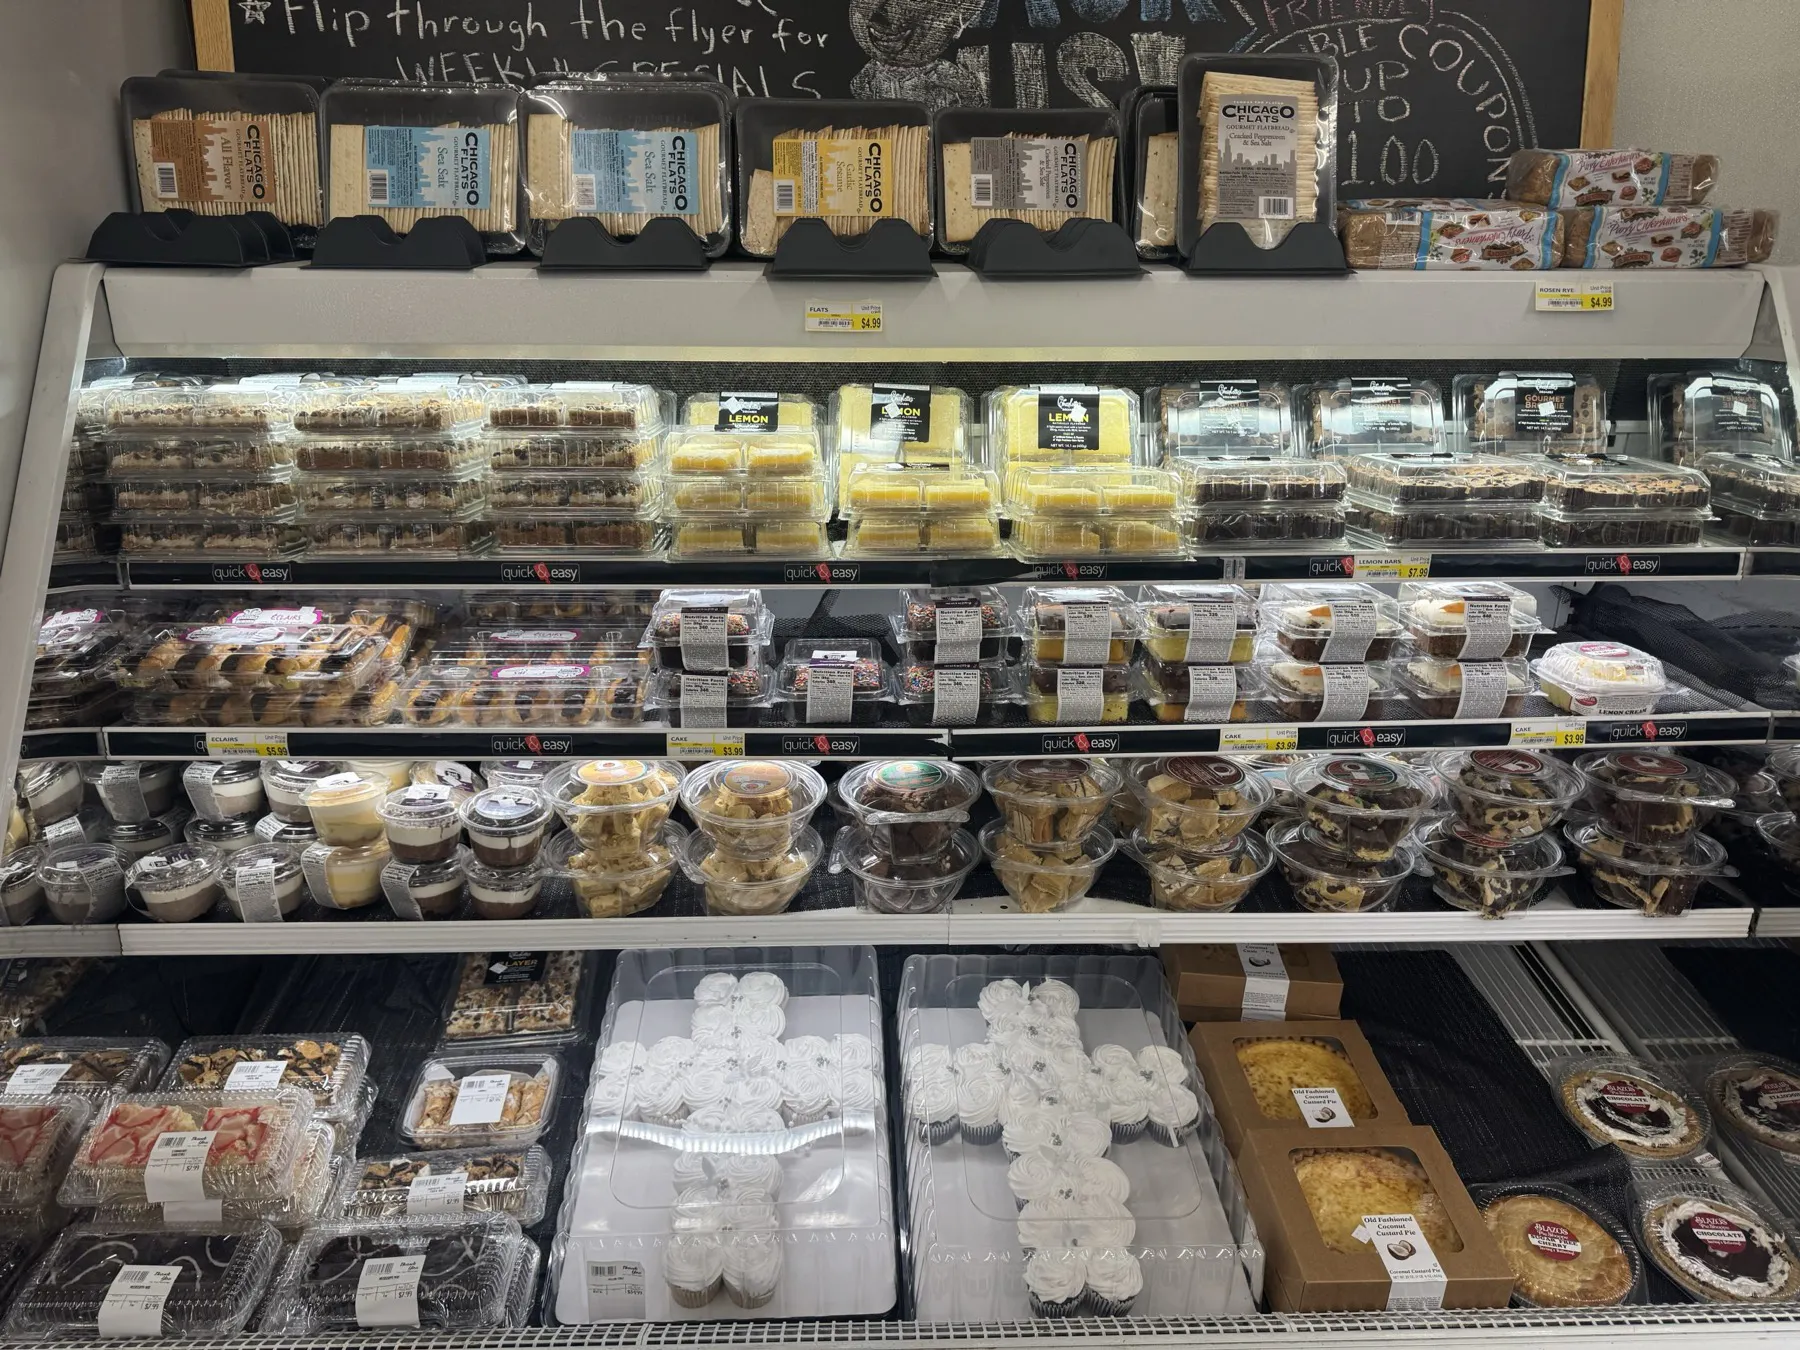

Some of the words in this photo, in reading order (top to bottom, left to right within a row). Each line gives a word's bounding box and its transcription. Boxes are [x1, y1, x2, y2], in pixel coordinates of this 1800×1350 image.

[387, 0, 547, 52] through
[570, 0, 646, 40] the
[665, 8, 753, 54] flyer
[772, 18, 828, 52] for
[1343, 60, 1410, 92] UP
[1222, 105, 1295, 119] CHICAGO
[1340, 95, 1411, 122] TO
[1399, 23, 1512, 200] COUPON
[1238, 115, 1279, 123] FLATS
[244, 141, 255, 183] FLATS
[247, 124, 265, 199] CHICAGO
[438, 147, 448, 165] Sea
[645, 151, 655, 170] Sea
[1341, 130, 1440, 185] 1.00
[461, 149, 469, 190] FLATS
[465, 132, 479, 205] CHICAGO
[669, 152, 677, 194] FLATS
[672, 135, 688, 210] CHICAGO
[1064, 143, 1078, 208] CHICAGO
[438, 169, 449, 188] Salt
[645, 173, 657, 193] Salt
[869, 143, 882, 213] CHICAGO
[1590, 297, 1612, 308] $4.99
[862, 318, 881, 329] $4.99
[1525, 394, 1566, 402] GOURMET
[728, 414, 769, 424] LEMON
[881, 407, 921, 416] LON
[1049, 413, 1089, 422] LEMN
[214, 566, 245, 580] quick
[262, 568, 289, 581] easy
[503, 565, 535, 580] quick
[551, 567, 578, 581] easy
[1033, 564, 1064, 579] quick
[1079, 565, 1105, 578] easy
[1311, 560, 1342, 574] quick
[1408, 568, 1428, 578] $7.99
[1587, 558, 1617, 574] quick
[1632, 559, 1659, 574] easy
[785, 567, 817, 581] quick
[832, 568, 858, 581] easy
[1329, 731, 1360, 746] quick
[1376, 732, 1404, 746] easy
[1564, 734, 1584, 745] $3.99
[1612, 725, 1642, 738] quick
[1659, 726, 1685, 739] easy
[493, 738, 526, 753] quick
[542, 740, 570, 754] easy
[784, 738, 815, 753] quick
[831, 739, 858, 753] easy
[1044, 736, 1075, 751] quick
[1090, 737, 1118, 751] easy
[1275, 741, 1297, 751] $3.99
[266, 747, 288, 756] $5.99
[723, 747, 744, 756] $3.99
[1606, 1095, 1649, 1103] CHOCOLATE
[1696, 1230, 1744, 1239] CHOCOLATE
[1537, 1240, 1567, 1249] CHERRY
